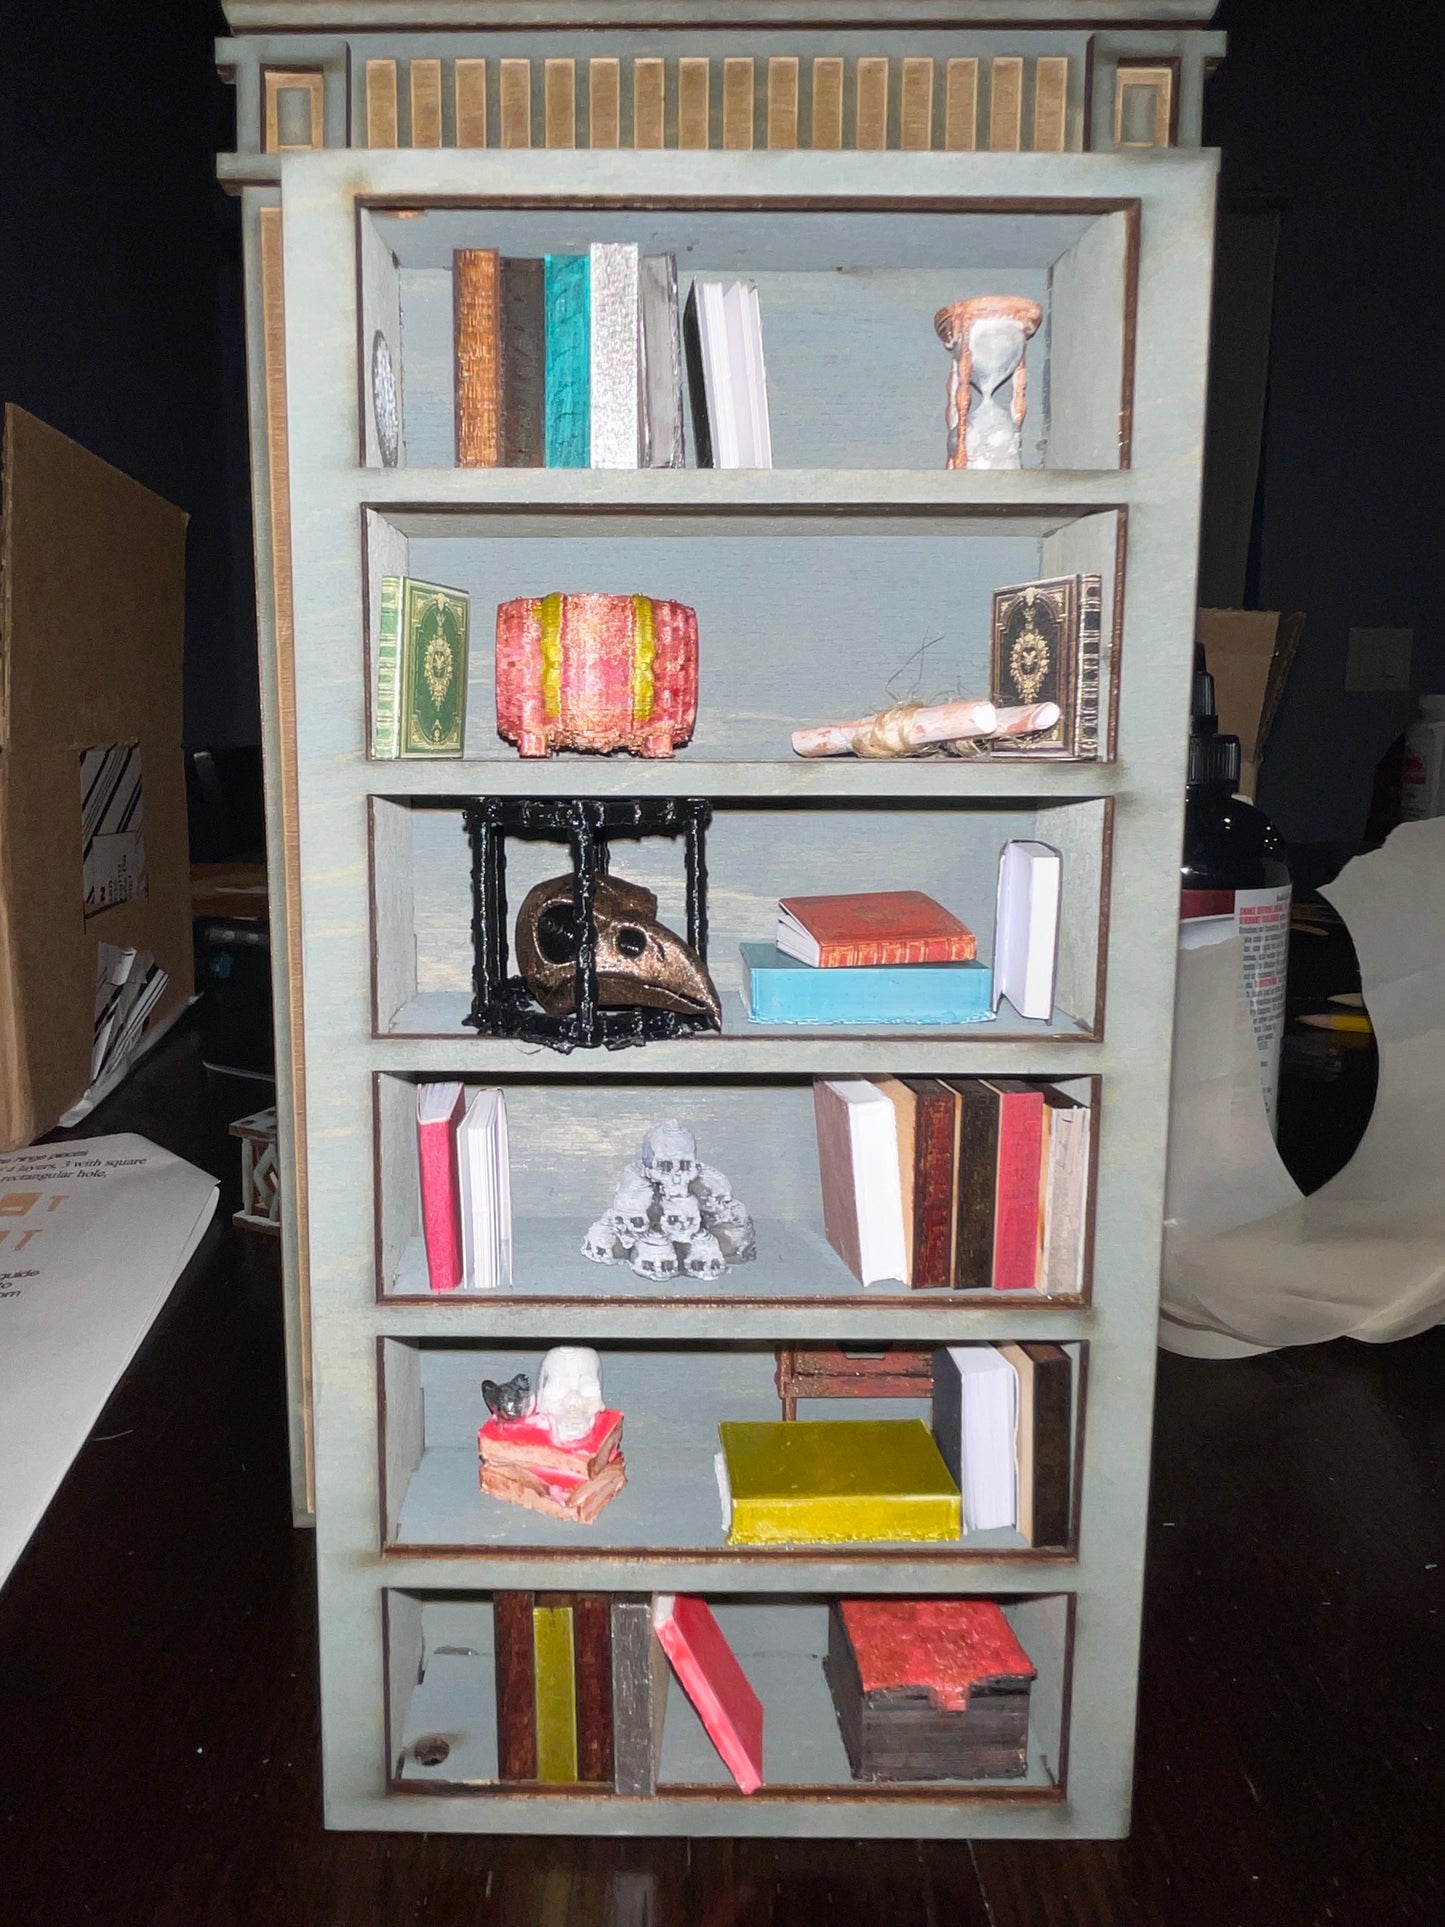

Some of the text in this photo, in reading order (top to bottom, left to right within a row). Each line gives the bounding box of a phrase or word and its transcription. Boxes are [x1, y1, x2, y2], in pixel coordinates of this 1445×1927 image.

[74, 1159, 101, 1167] with
[105, 1158, 147, 1168] square
[1, 1171, 73, 1181] rectangular
